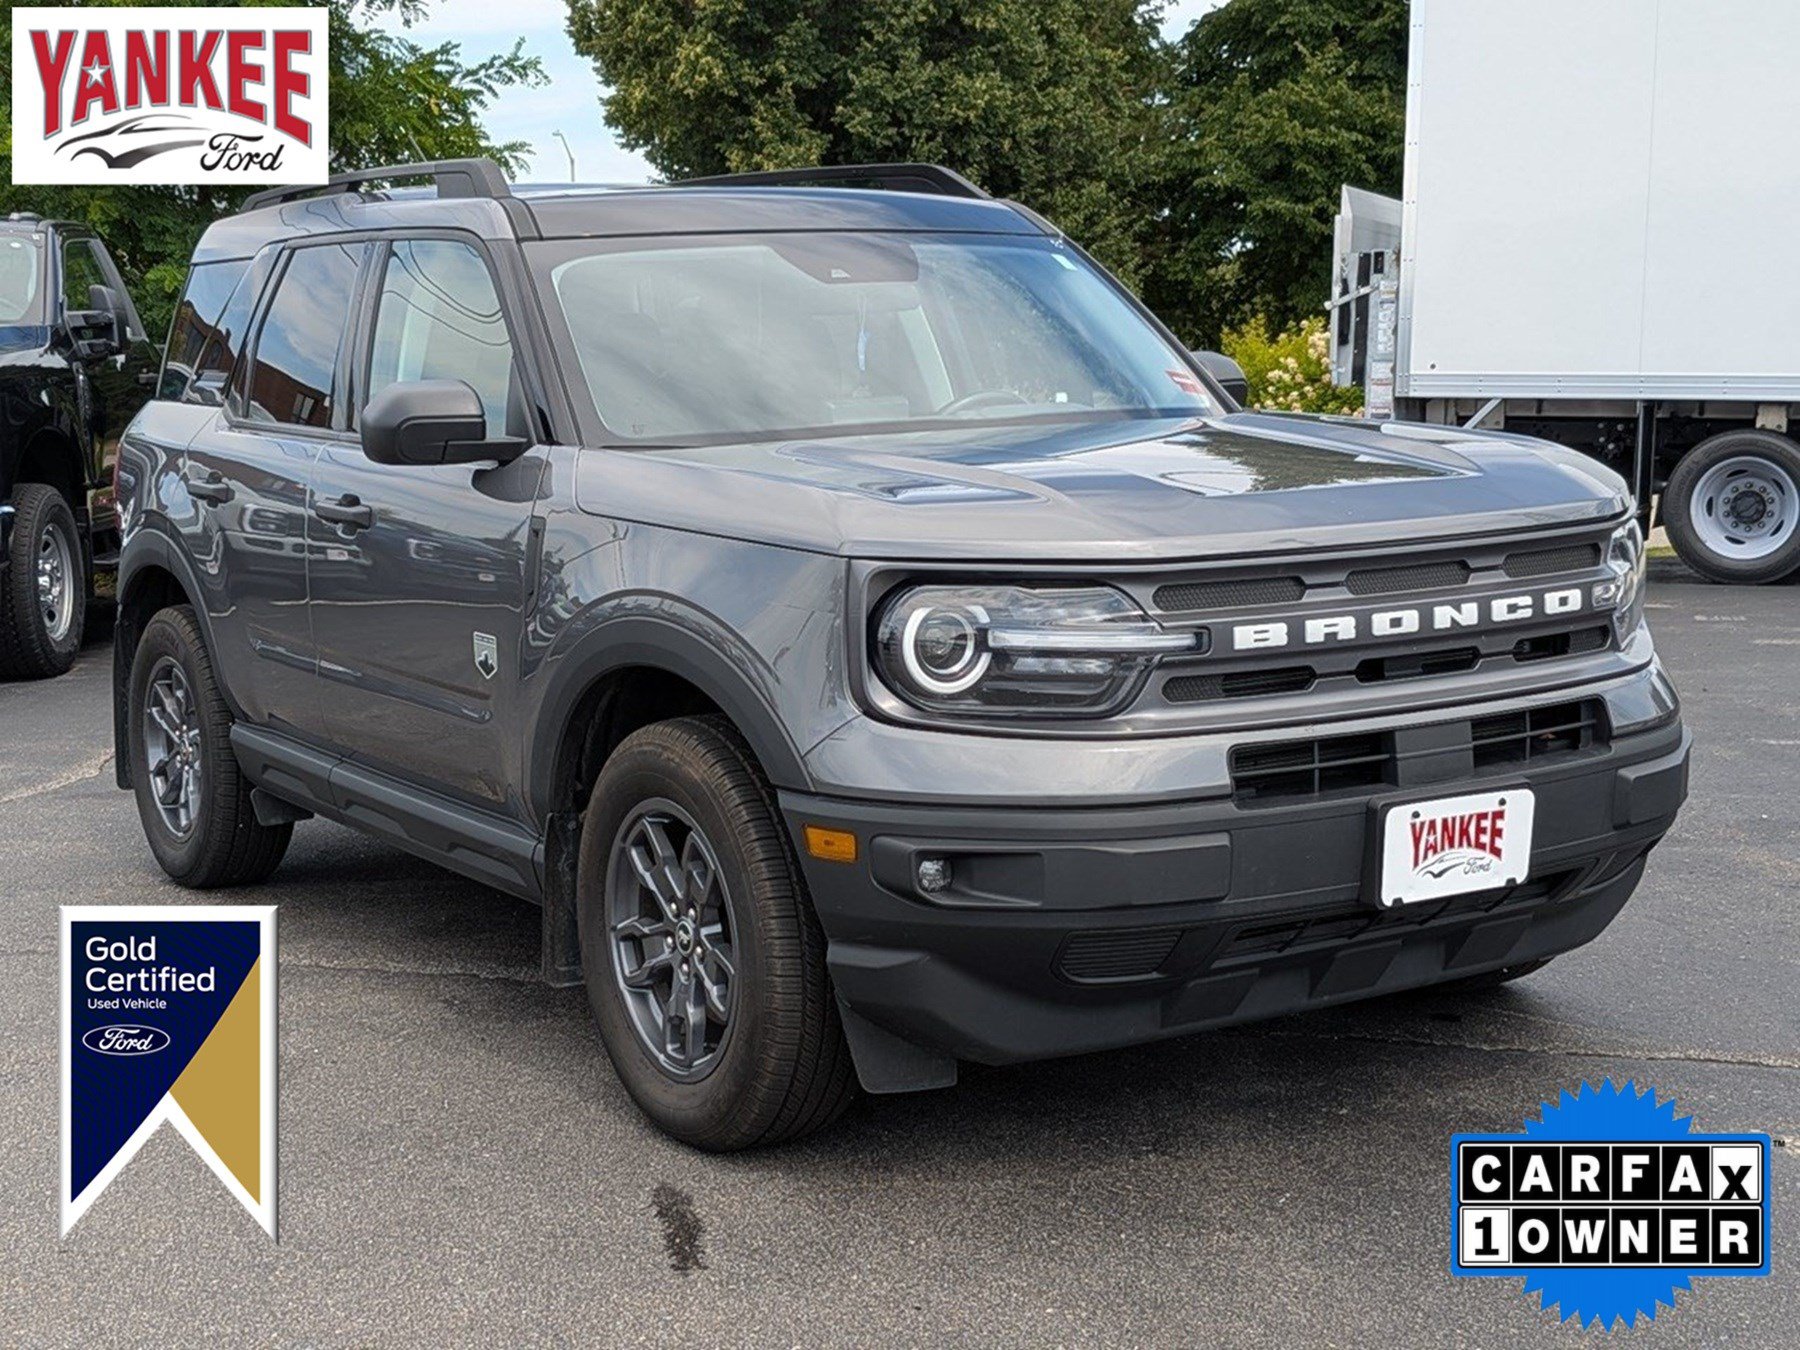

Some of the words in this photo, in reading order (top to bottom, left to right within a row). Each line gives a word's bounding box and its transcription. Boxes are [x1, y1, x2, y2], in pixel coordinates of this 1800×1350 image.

[1232, 589, 1583, 651] BRONCO
[1410, 809, 1505, 871] YANKEE
[1464, 856, 1493, 875] Ford
